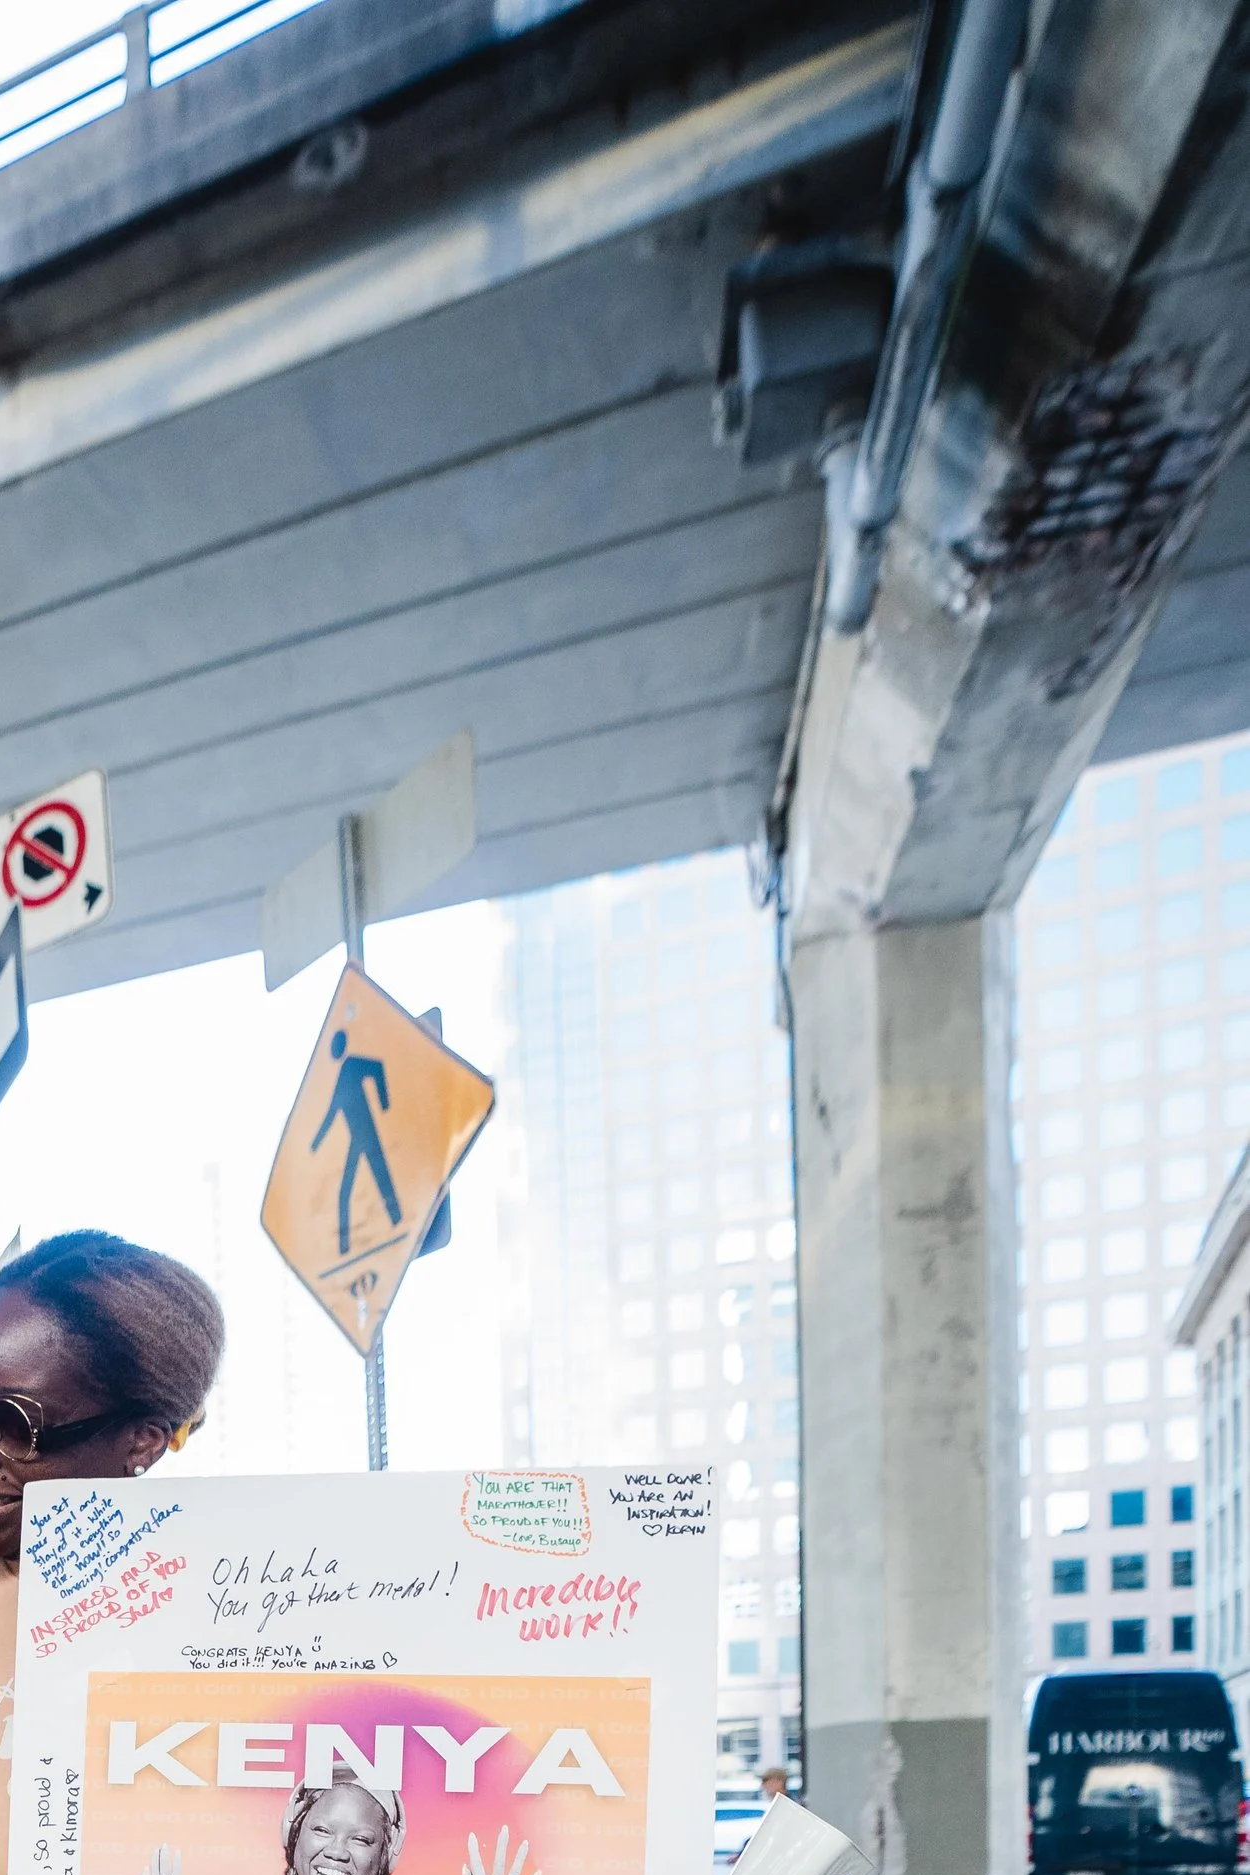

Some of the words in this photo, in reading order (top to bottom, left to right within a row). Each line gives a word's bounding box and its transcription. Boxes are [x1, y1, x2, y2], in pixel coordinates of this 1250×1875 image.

[506, 1481, 535, 1494] ARE
[542, 1482, 573, 1493] THAT
[673, 1490, 694, 1502] AN
[55, 1511, 77, 1539] goal
[79, 1491, 97, 1512] and
[491, 1515, 532, 1527] PROUD
[41, 1550, 79, 1583] juggling
[79, 1508, 124, 1549] everything
[538, 1534, 581, 1552] Busayo
[30, 1585, 119, 1644] INSPIRED
[120, 1551, 162, 1588] AND
[59, 1562, 108, 1599] amazing!
[476, 1572, 642, 1621] Incredible
[35, 1642, 57, 1659] SO
[62, 1601, 122, 1643] PROUD
[126, 1579, 150, 1600] OF
[153, 1556, 187, 1580] YOU
[207, 1588, 248, 1624] You
[257, 1590, 303, 1633] got
[181, 1645, 248, 1657] CONGRATS
[255, 1645, 303, 1659] KENYA
[189, 1658, 210, 1670] You
[217, 1658, 238, 1668] did
[107, 1720, 626, 1797] KENYA
[34, 1777, 57, 1828] proud
